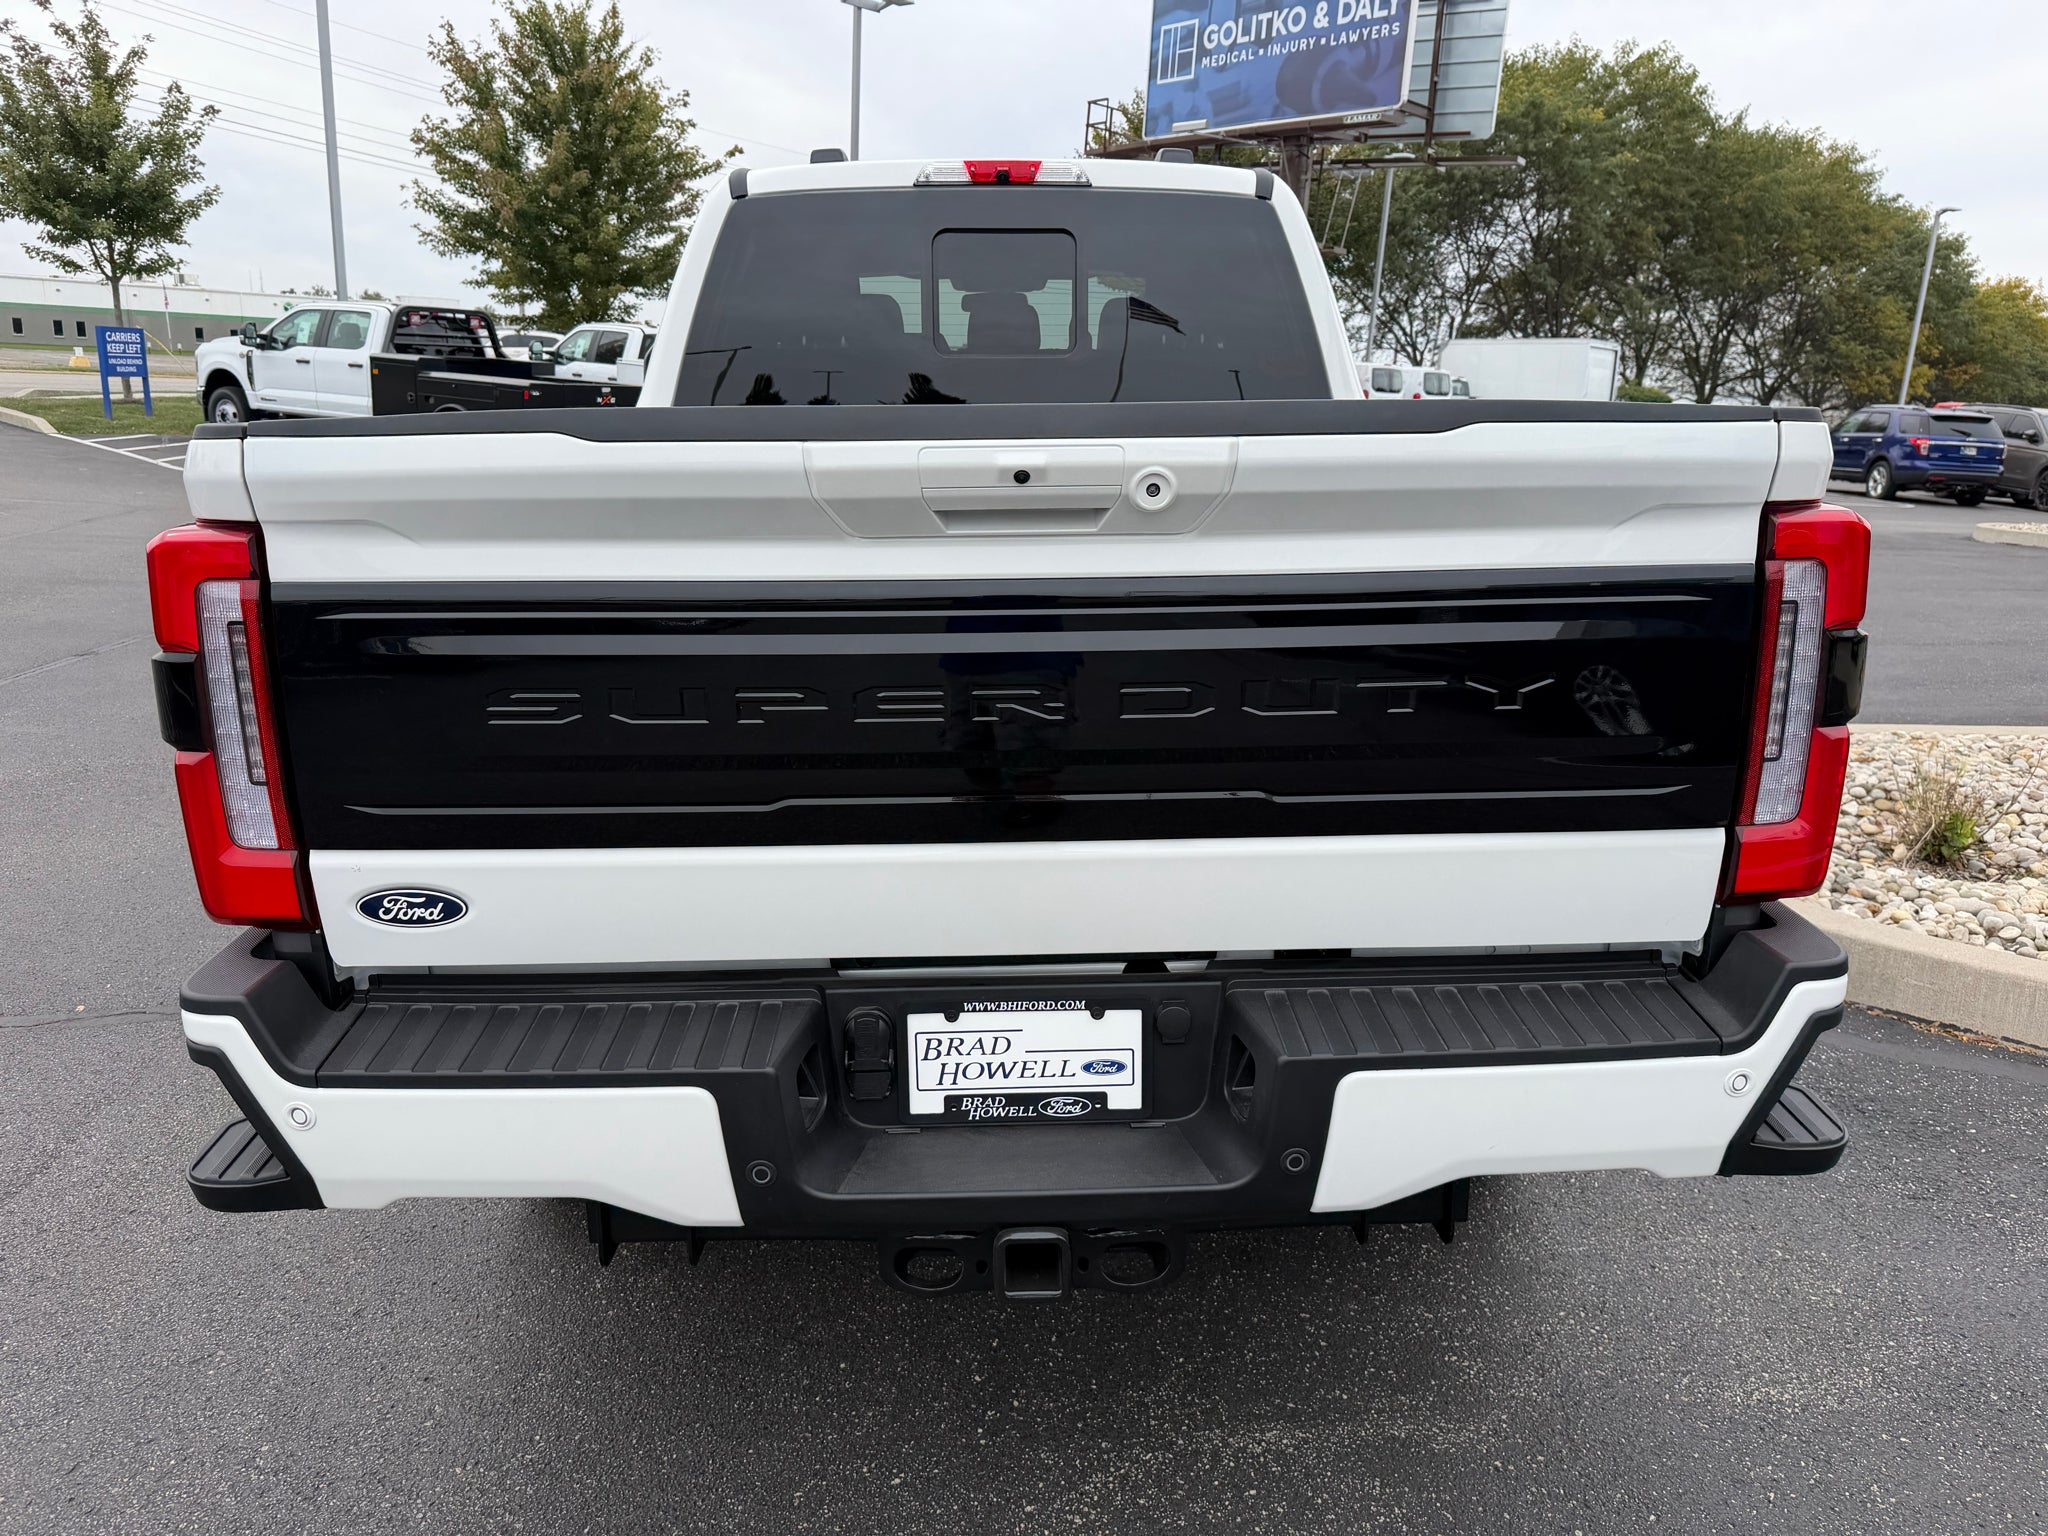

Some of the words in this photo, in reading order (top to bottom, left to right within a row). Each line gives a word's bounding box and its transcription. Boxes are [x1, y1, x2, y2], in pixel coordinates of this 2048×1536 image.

[1203, 7, 1307, 49] GOLITKO
[1313, 1, 1329, 29] &
[1201, 49, 1255, 69] MEDICAL
[1267, 36, 1316, 57] INJURY
[1330, 22, 1401, 46] LAWYERS
[105, 331, 141, 342] CARRIERS
[106, 343, 124, 353] KEEP
[125, 344, 141, 353] LEFT
[485, 686, 1067, 725] SUPER
[1118, 675, 1557, 719] DUTY
[378, 895, 445, 921] Ford
[963, 1000, 1086, 1012] WWW.BHIFORD.COM
[921, 1036, 1012, 1061] BRAD
[936, 1059, 1076, 1086] HOWELL
[1089, 1060, 1118, 1074] Ford
[961, 1097, 1006, 1110] BRAD
[968, 1105, 1037, 1121] HOWELL
[1047, 1099, 1084, 1114] Ford
